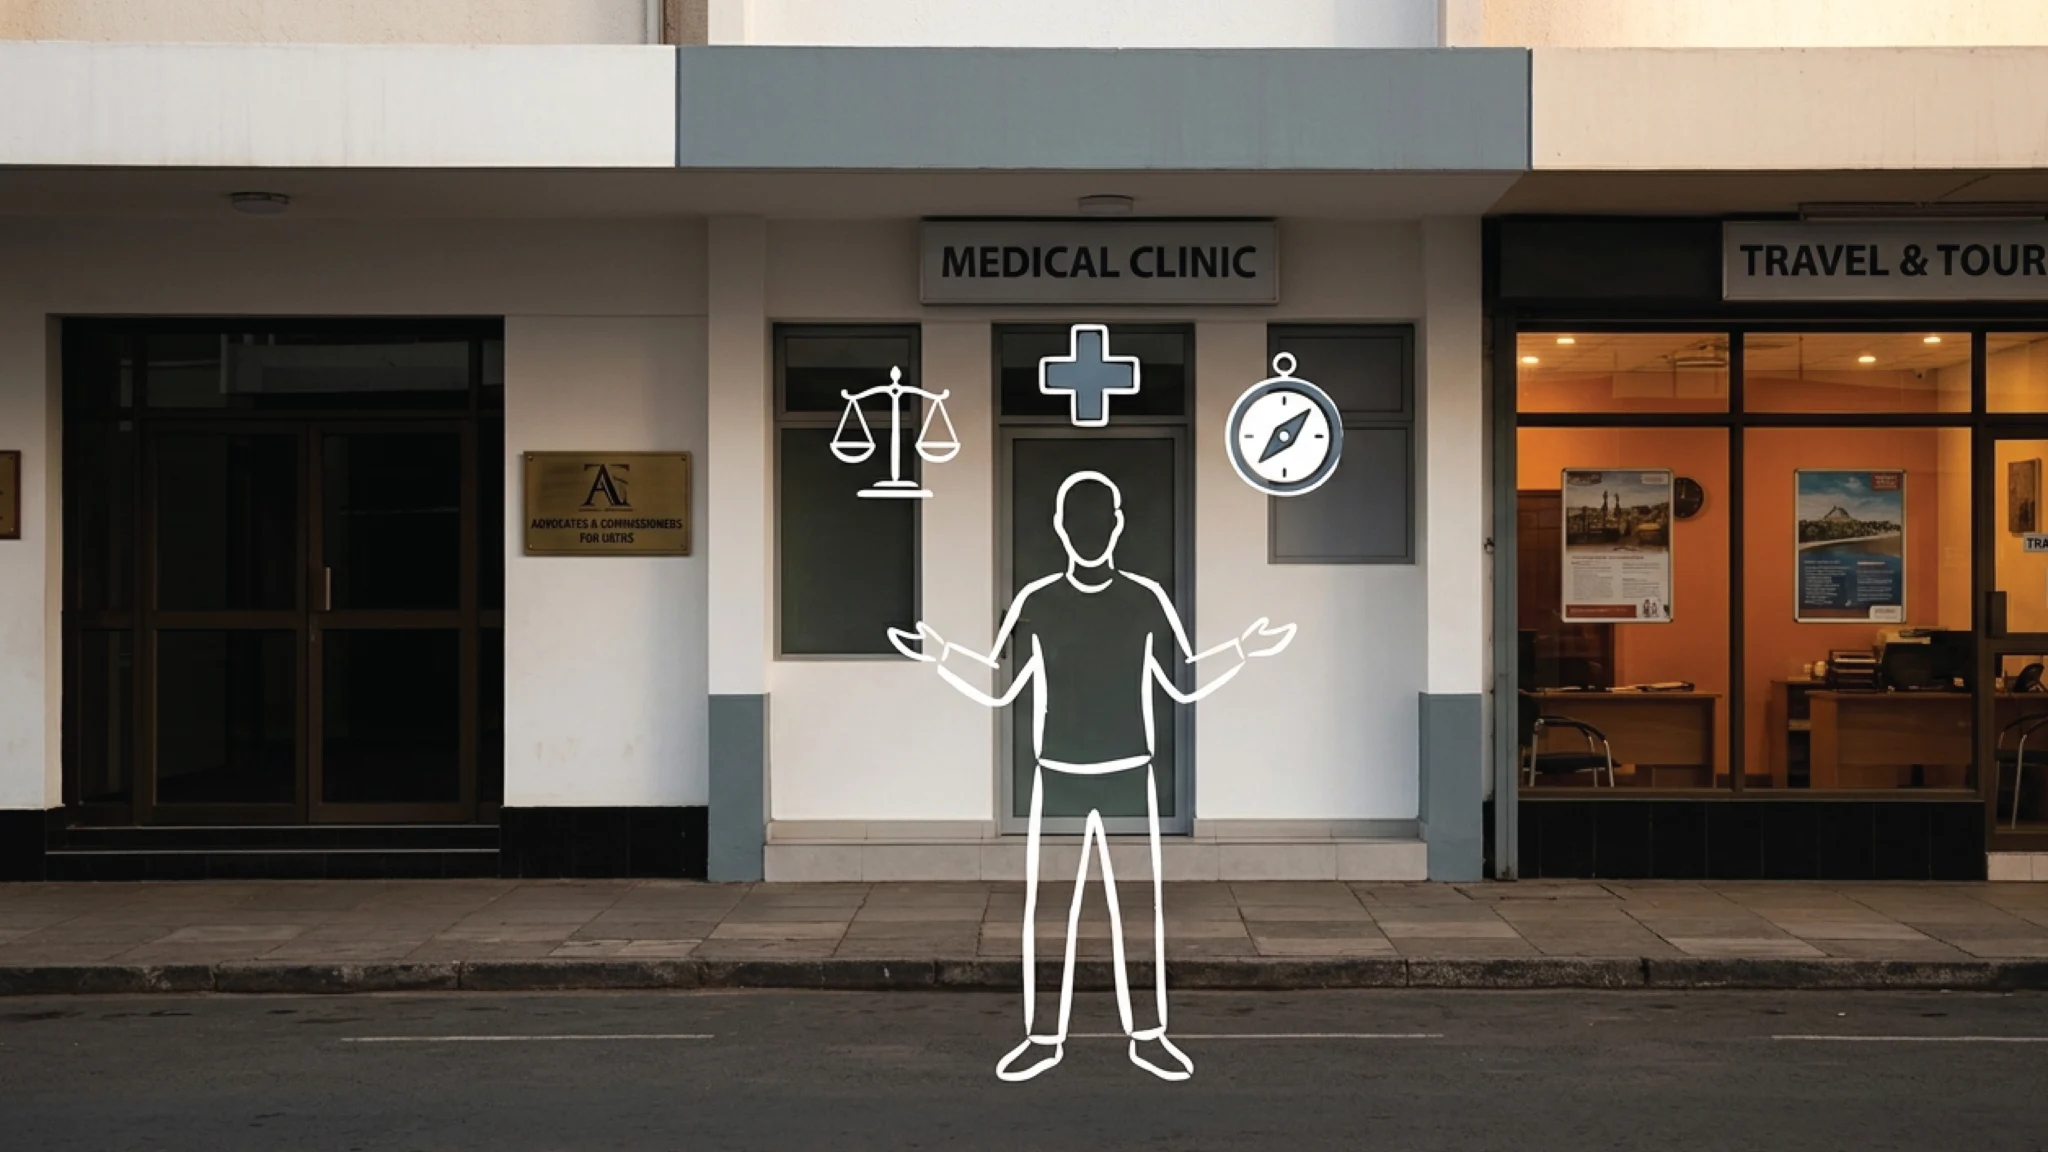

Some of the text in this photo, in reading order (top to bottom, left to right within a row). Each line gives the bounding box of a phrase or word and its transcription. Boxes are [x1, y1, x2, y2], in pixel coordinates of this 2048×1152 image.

[942, 245, 1257, 279] MEDICAL CLINIC
[1740, 243, 2048, 277] TRAVEL & TOUR
[580, 532, 599, 543] FOR
[2026, 537, 2048, 549] TRA
